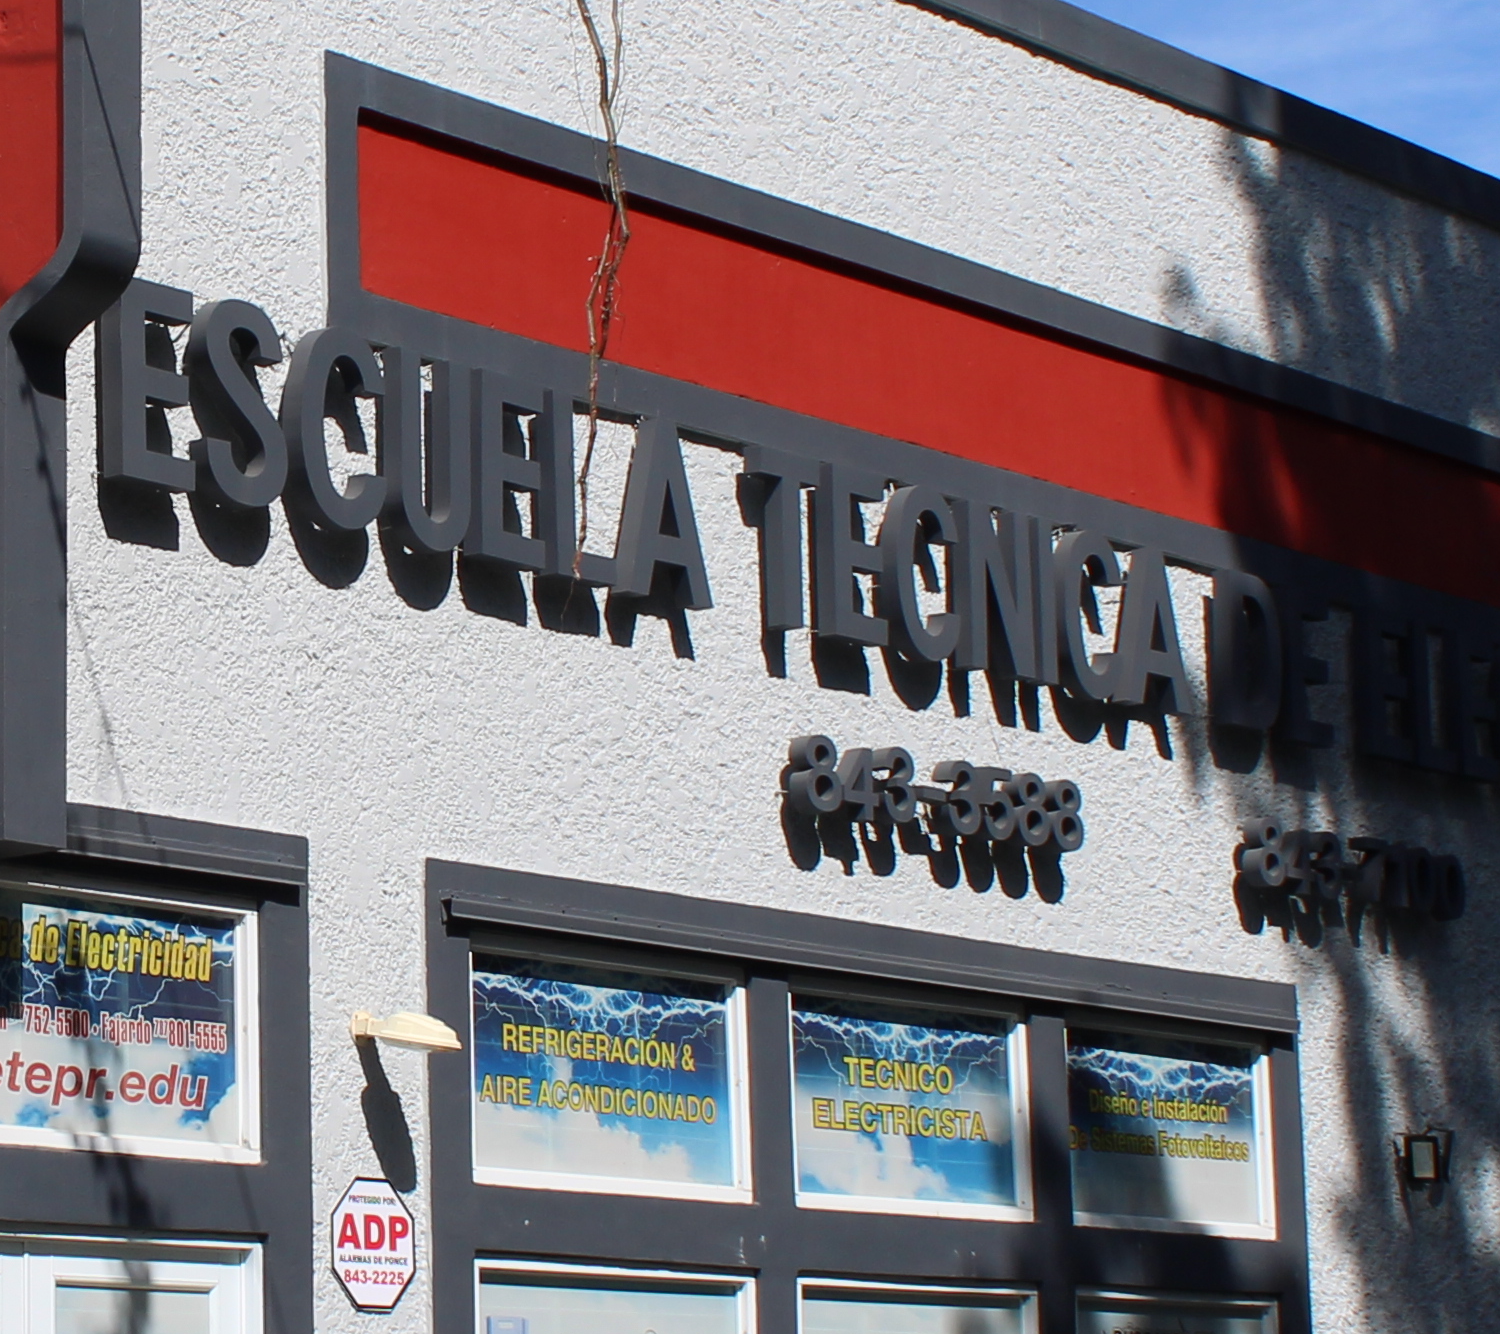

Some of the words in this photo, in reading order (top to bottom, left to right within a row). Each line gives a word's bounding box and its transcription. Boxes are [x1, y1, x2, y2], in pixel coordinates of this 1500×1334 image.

[98, 277, 713, 610] ESCUELA
[741, 444, 1193, 717] TECNICA
[1207, 565, 1336, 750] DE
[788, 734, 1084, 853] 843-3588
[1240, 816, 1466, 922] 843-7100
[29, 914, 61, 964] de
[65, 920, 213, 983] Electricidad
[25, 1003, 90, 1038] 752-5500
[100, 1011, 152, 1047] Fajardo
[168, 1019, 228, 1054] 801-5555
[501, 1022, 677, 1070] REFRIGERACIÓN
[681, 1043, 696, 1072] &
[842, 1055, 955, 1096] TECNICO
[479, 1073, 533, 1107] AIRE
[537, 1079, 717, 1126] ACONDICIONADO
[812, 1097, 989, 1142] ELECTRICISTA
[1088, 1088, 1138, 1117] Diseño
[1141, 1099, 1150, 1117] e
[1152, 1094, 1228, 1125] Instalación
[1068, 1124, 1088, 1151] De
[1090, 1124, 1156, 1157] Sistemas
[1157, 1129, 1250, 1163] Fotovoltaicos
[348, 1194, 382, 1205] PROTEGIDO
[337, 1212, 409, 1252] ADP
[339, 1254, 372, 1265] ALARMAS
[373, 1255, 383, 1265] DE
[384, 1257, 408, 1266] PONCE
[343, 1269, 405, 1286] 843-2225
